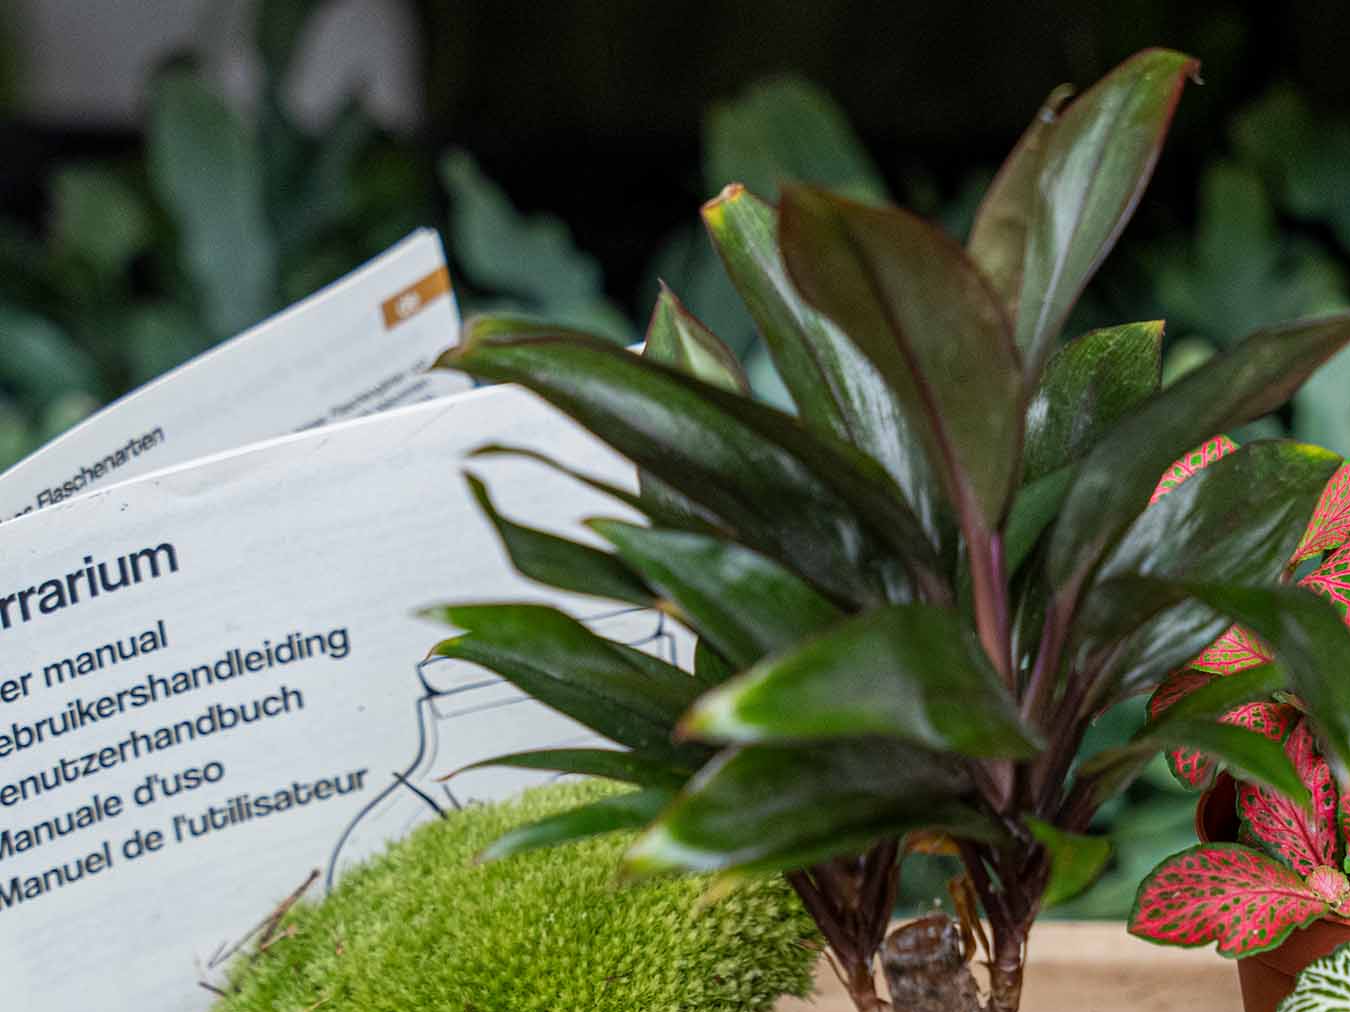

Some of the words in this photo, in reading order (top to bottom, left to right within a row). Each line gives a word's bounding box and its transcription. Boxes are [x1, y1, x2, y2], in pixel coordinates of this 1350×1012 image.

[43, 619, 168, 688] manual
[122, 830, 164, 860] de
[172, 768, 368, 843] l'utilisateur
[133, 761, 225, 806] d'uso
